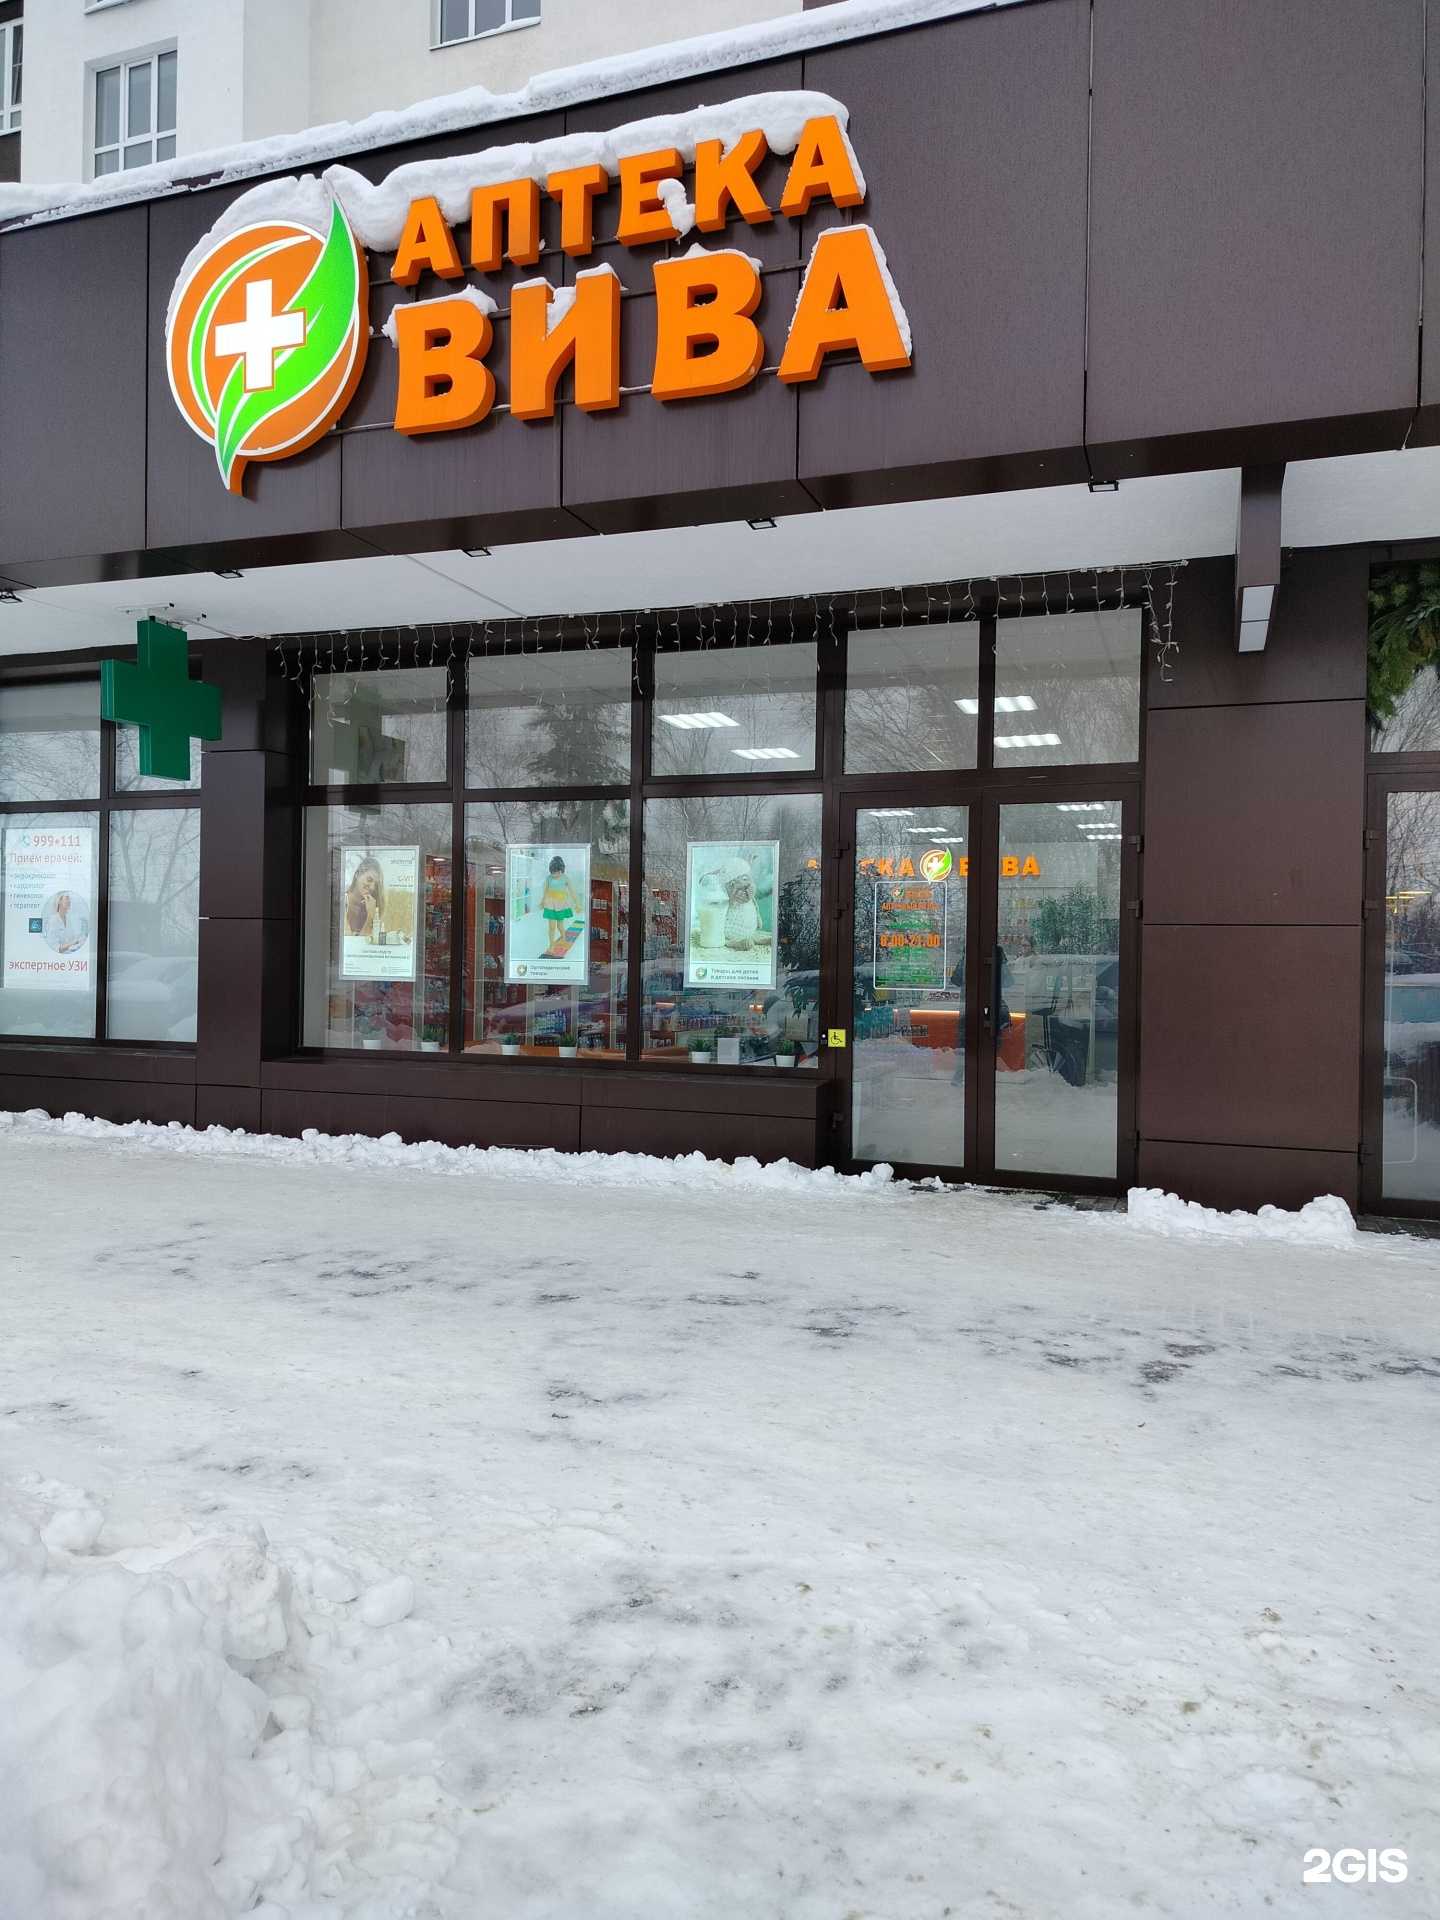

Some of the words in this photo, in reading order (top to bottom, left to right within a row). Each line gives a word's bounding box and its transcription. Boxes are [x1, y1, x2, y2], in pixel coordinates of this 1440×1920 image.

[390, 115, 865, 285] АПТЕКА
[394, 224, 912, 436] ВИВА
[8, 960, 65, 974] экспертное
[68, 960, 88, 972] УЗИ
